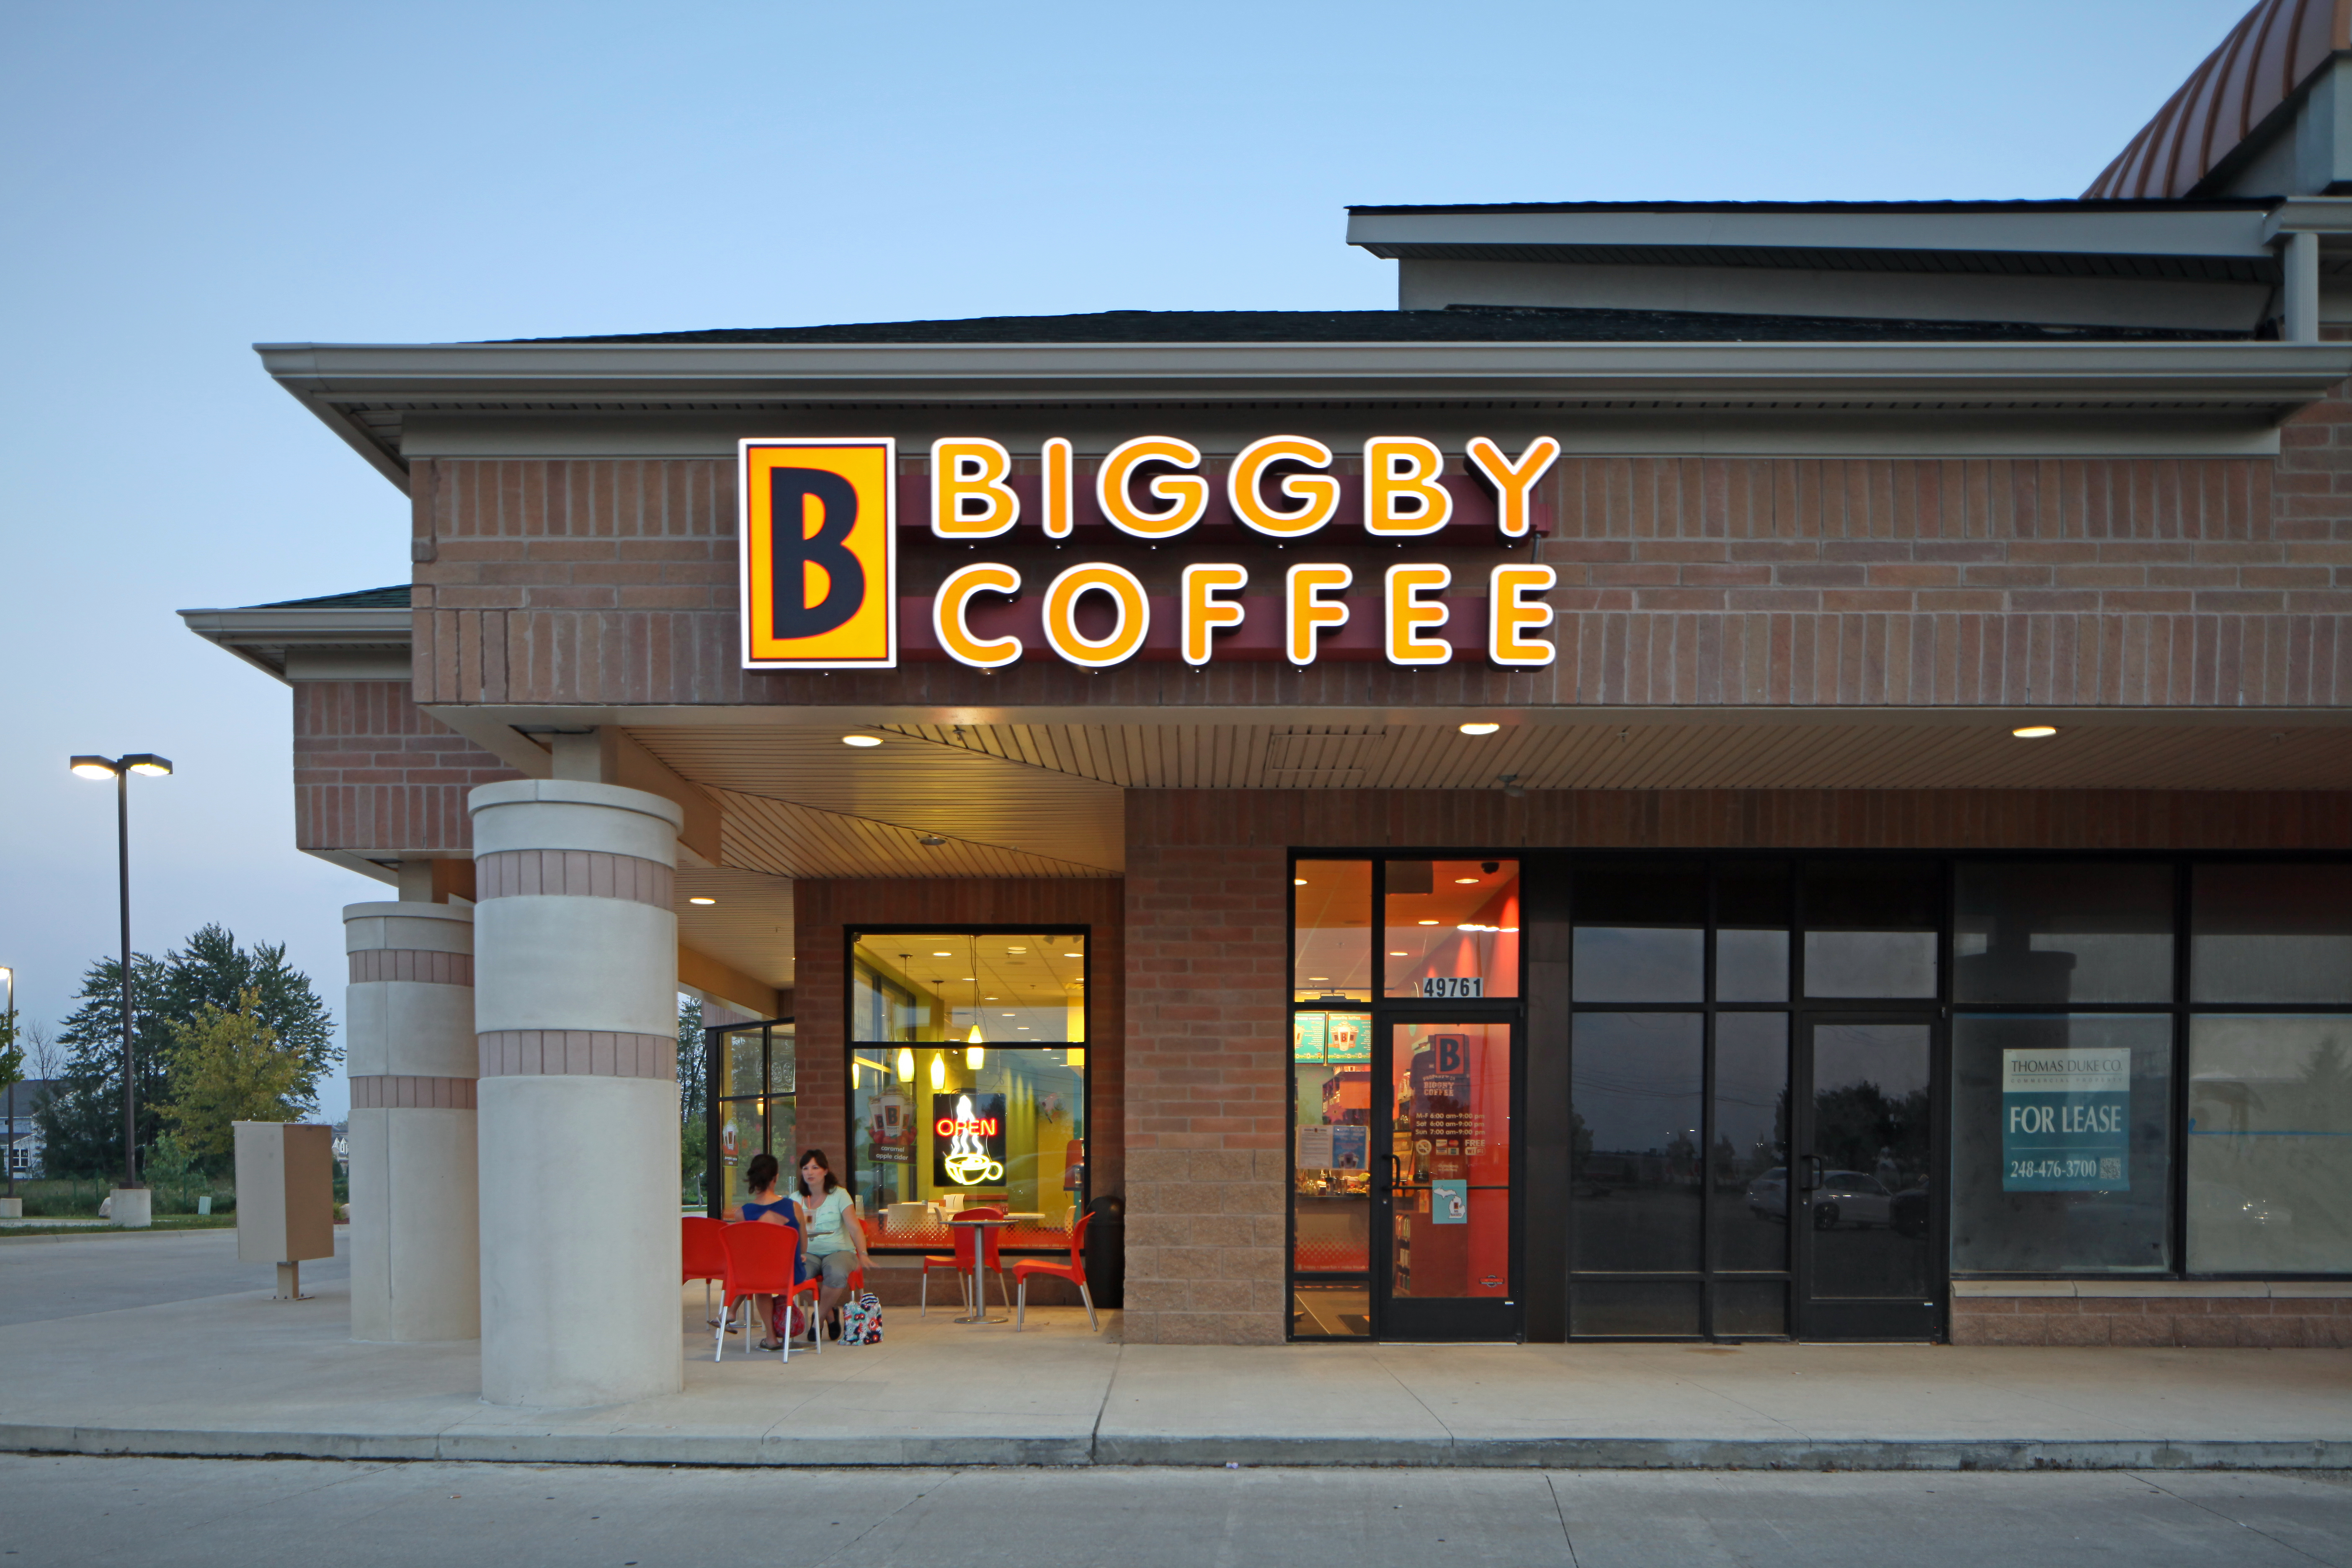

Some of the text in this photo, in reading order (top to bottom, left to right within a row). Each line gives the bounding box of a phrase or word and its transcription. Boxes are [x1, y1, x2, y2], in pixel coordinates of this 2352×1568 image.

[931, 435, 1561, 539] BIGGBY
[770, 467, 866, 641] B
[933, 562, 1557, 670] COFFEE
[1424, 978, 1480, 997] 49761
[1440, 1038, 1460, 1071] B
[2012, 1060, 2123, 1072] THOMAS DUKE CO.
[887, 1108, 897, 1124] B
[936, 1117, 998, 1137] OPEN
[2011, 1106, 2121, 1133] FOR LEASE
[2011, 1161, 2097, 1177] 248-476-3700
